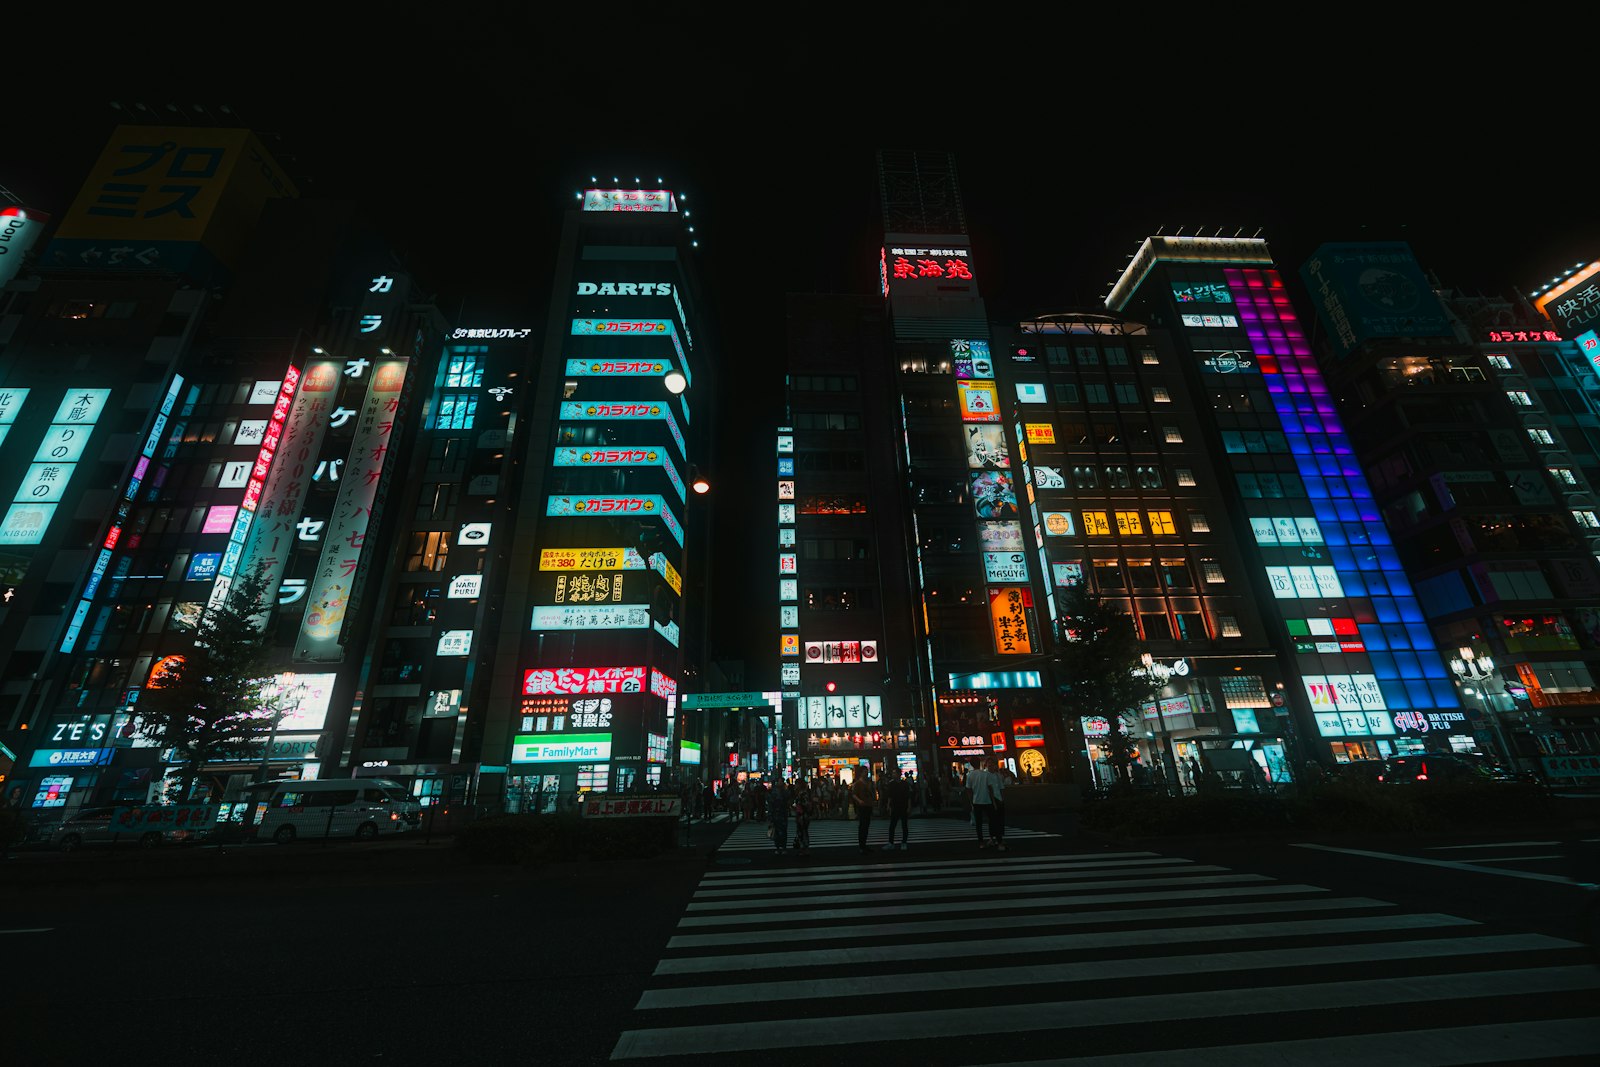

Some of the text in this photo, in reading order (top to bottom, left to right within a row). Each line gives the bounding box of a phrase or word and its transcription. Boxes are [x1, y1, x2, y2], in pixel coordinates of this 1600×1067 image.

[113, 141, 225, 178] プロ
[88, 182, 203, 219] ミス
[893, 256, 973, 280] 東海苑
[576, 282, 672, 296] DARTS
[467, 328, 532, 338] 東京ビルグループ
[606, 322, 657, 332] カラオケ
[601, 362, 654, 373] カラオケ
[597, 405, 650, 416] カラオケ
[32, 393, 94, 498] 木彫りの熊の
[591, 450, 647, 462] カラオケ
[586, 499, 644, 512] カラオケ
[2, 529, 40, 538] KIBORI
[1255, 527, 1319, 537] 水の森美容外科
[97, 552, 111, 571] ZEST
[557, 558, 576, 567] 380
[579, 558, 617, 568] たけ田
[988, 569, 1025, 578] MASUYA
[455, 581, 477, 589] WARU
[562, 614, 625, 627] 新宿萬太郎
[586, 666, 646, 680] ハイボール
[525, 667, 585, 695] 銀だこ
[585, 679, 621, 693] 横丁
[623, 682, 640, 692] 2F
[1337, 681, 1377, 693] やよい軒
[1342, 693, 1376, 704] YAYOI
[811, 700, 822, 727] 牛たん
[827, 703, 881, 720] ねぎし
[1428, 713, 1466, 722] BRITISH
[1343, 715, 1382, 729] すし好
[1394, 711, 1430, 732] HUB
[1432, 721, 1451, 730] PUB
[542, 745, 598, 758] FamilyMart
